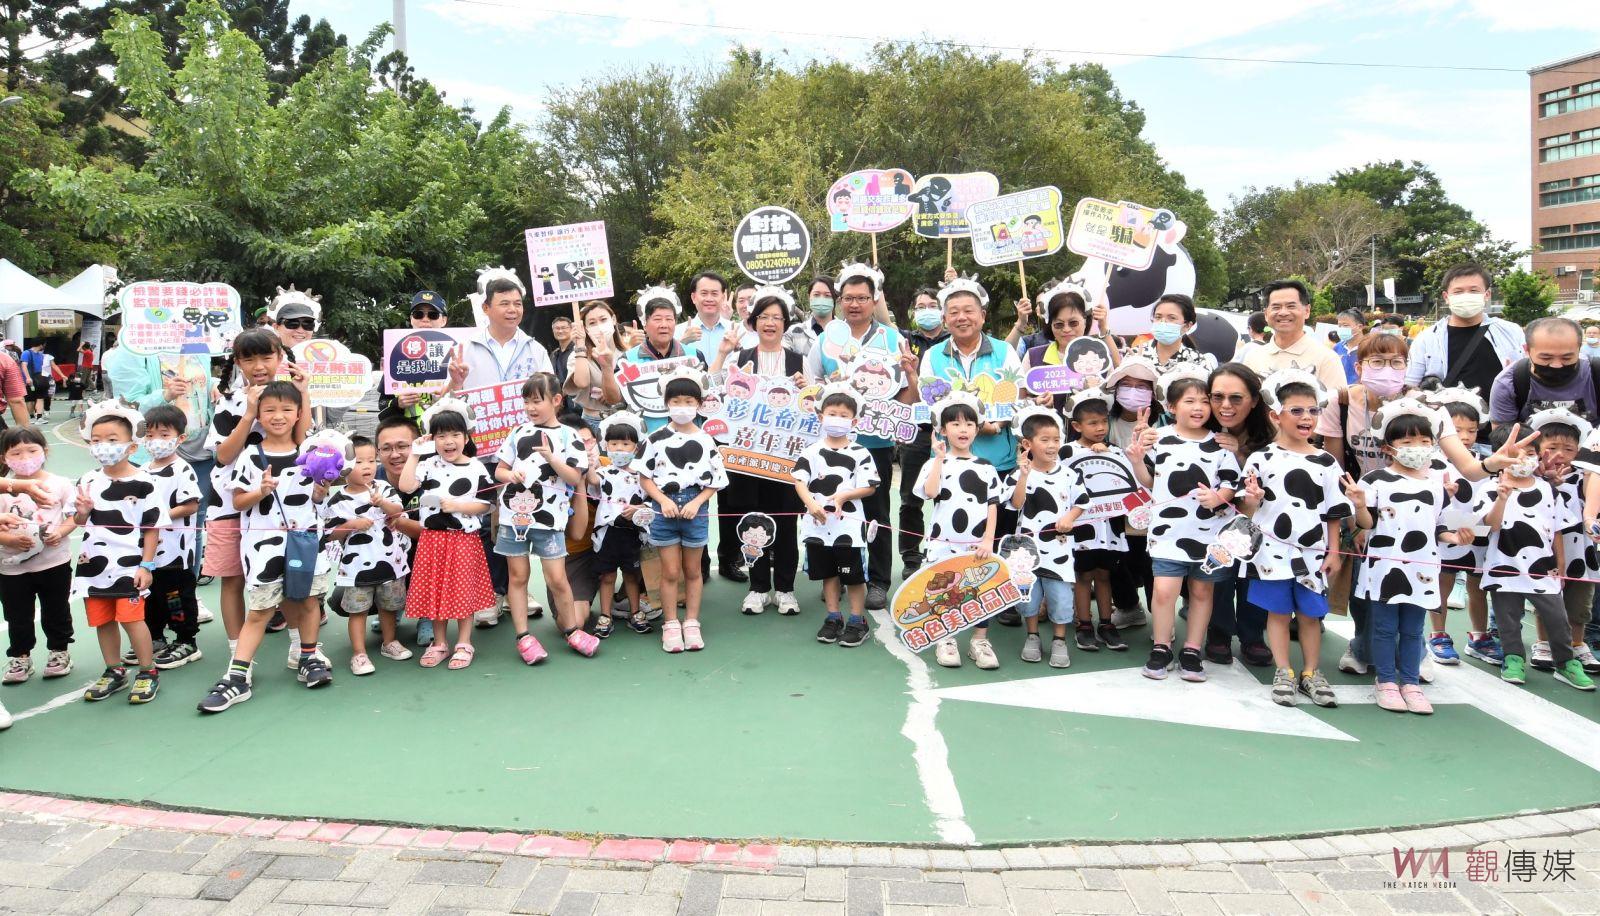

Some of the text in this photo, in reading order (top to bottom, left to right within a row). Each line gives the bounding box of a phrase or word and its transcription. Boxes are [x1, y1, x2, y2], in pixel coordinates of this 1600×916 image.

[749, 214, 792, 233] 對抗
[741, 233, 802, 253] 假訊息
[746, 257, 801, 270] 0800-024099#4
[133, 298, 229, 308] 監管帳戶都是騙
[429, 343, 444, 358] 讓
[1044, 370, 1066, 378] 2023
[1032, 378, 1079, 390] 彰化乳牛節
[727, 398, 820, 435] 彰化畜產
[858, 414, 916, 440] 乳牛節
[734, 426, 806, 456] 嘉年華
